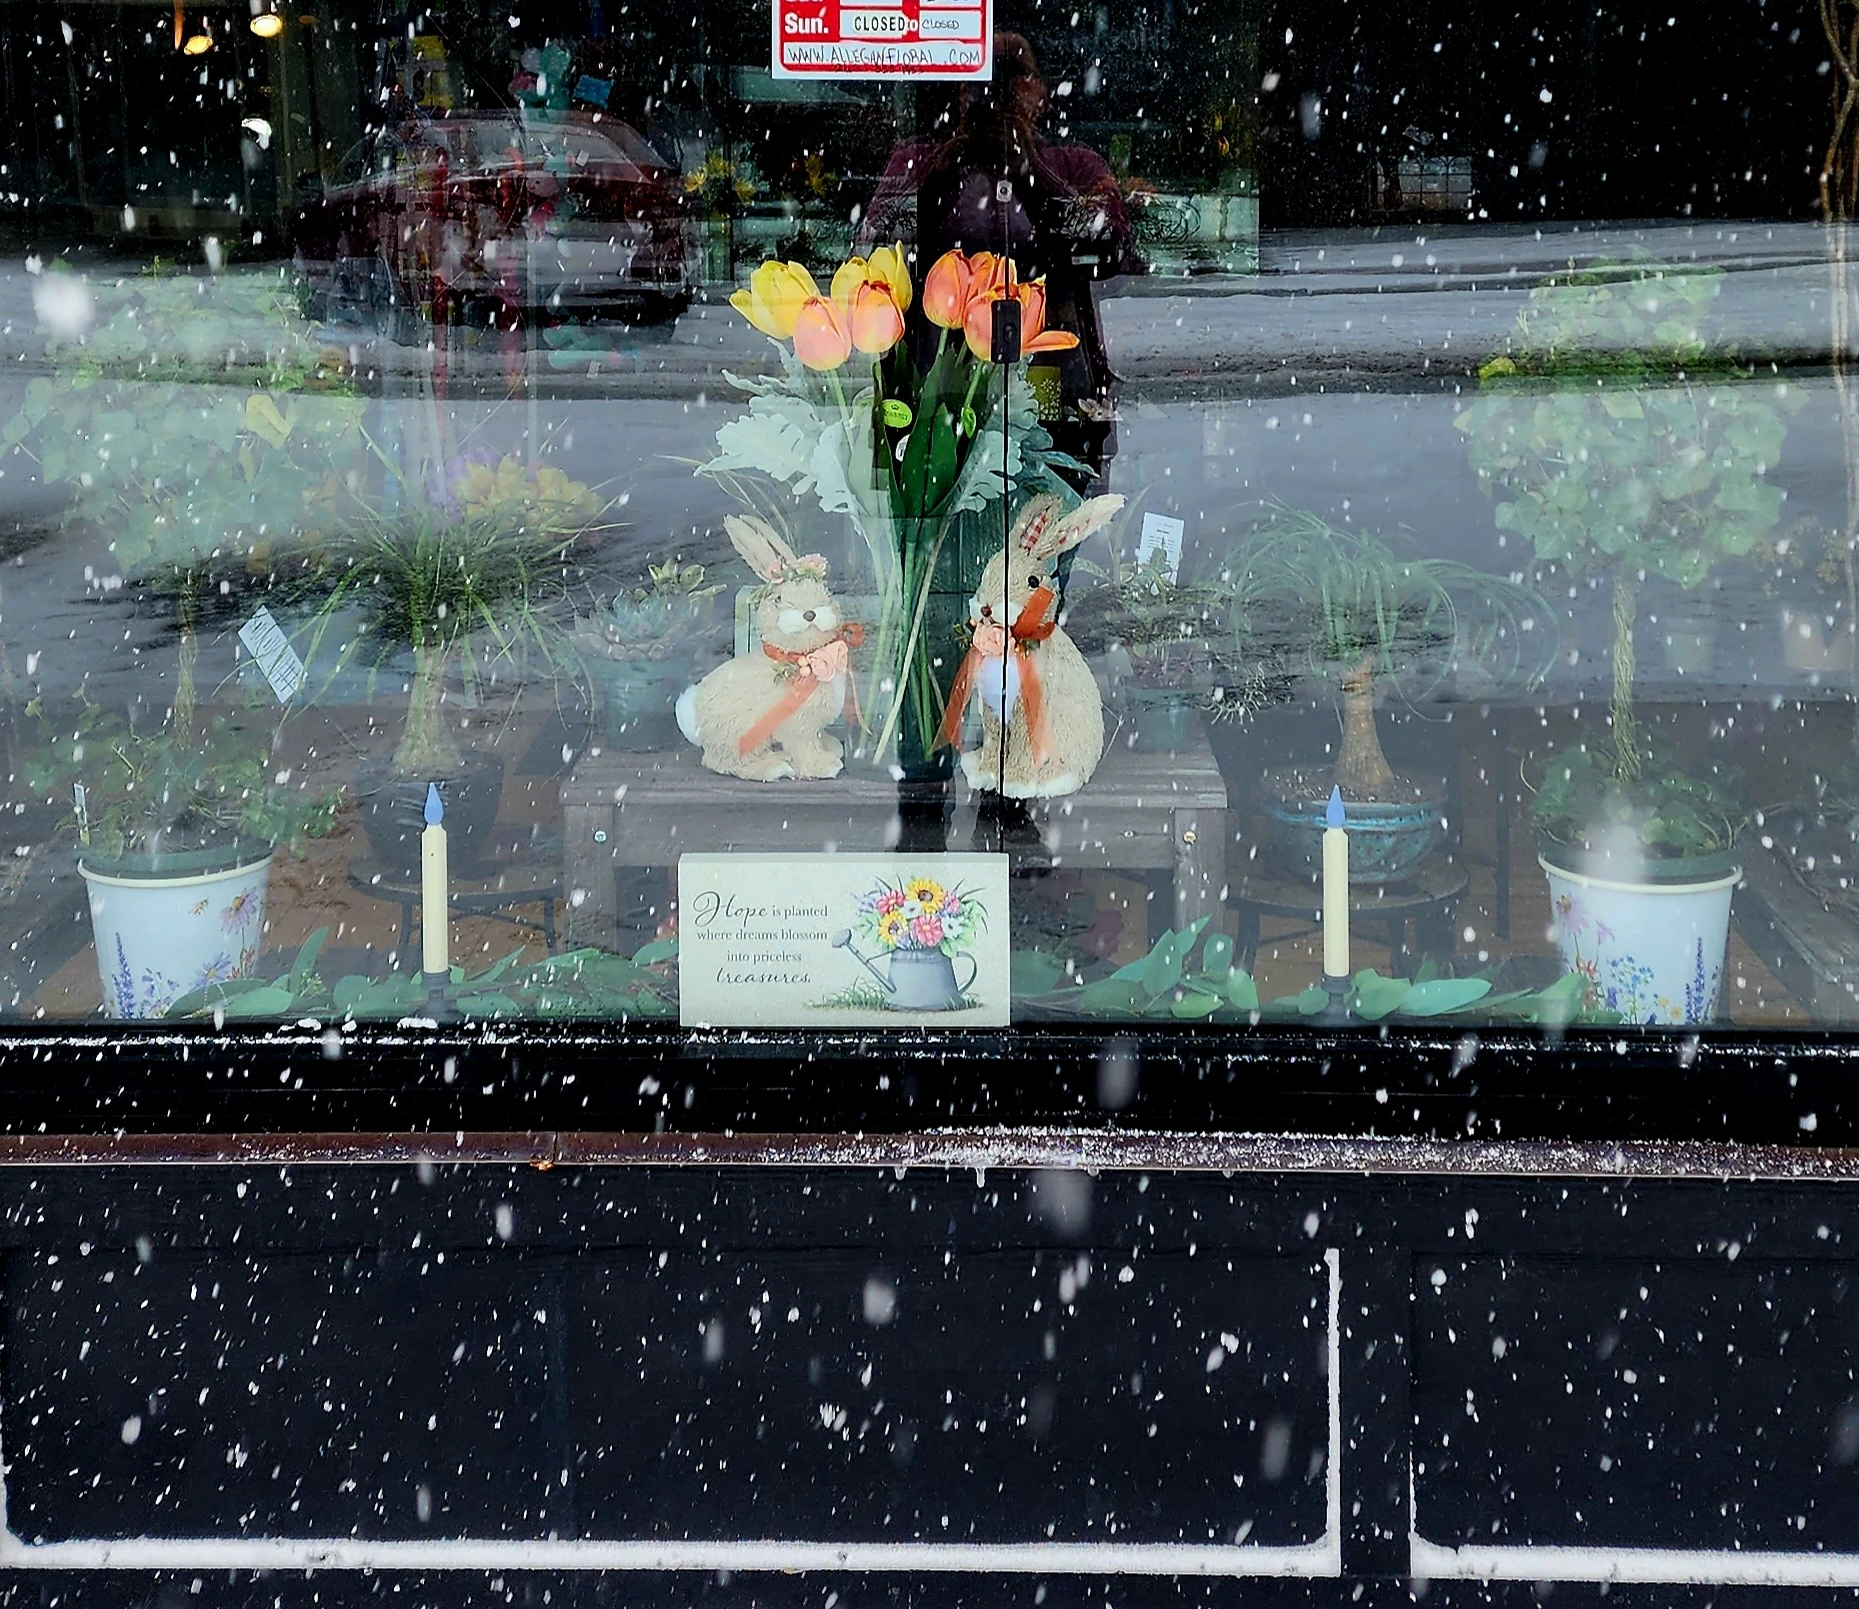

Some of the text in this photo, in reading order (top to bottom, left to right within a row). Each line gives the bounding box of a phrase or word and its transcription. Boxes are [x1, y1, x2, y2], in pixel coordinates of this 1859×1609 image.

[784, 11, 960, 34] Sun. CLOSED to CLOSED
[692, 891, 829, 927] Hope is planted
[696, 929, 828, 941] where dreams blossom
[727, 950, 802, 965] into priceless
